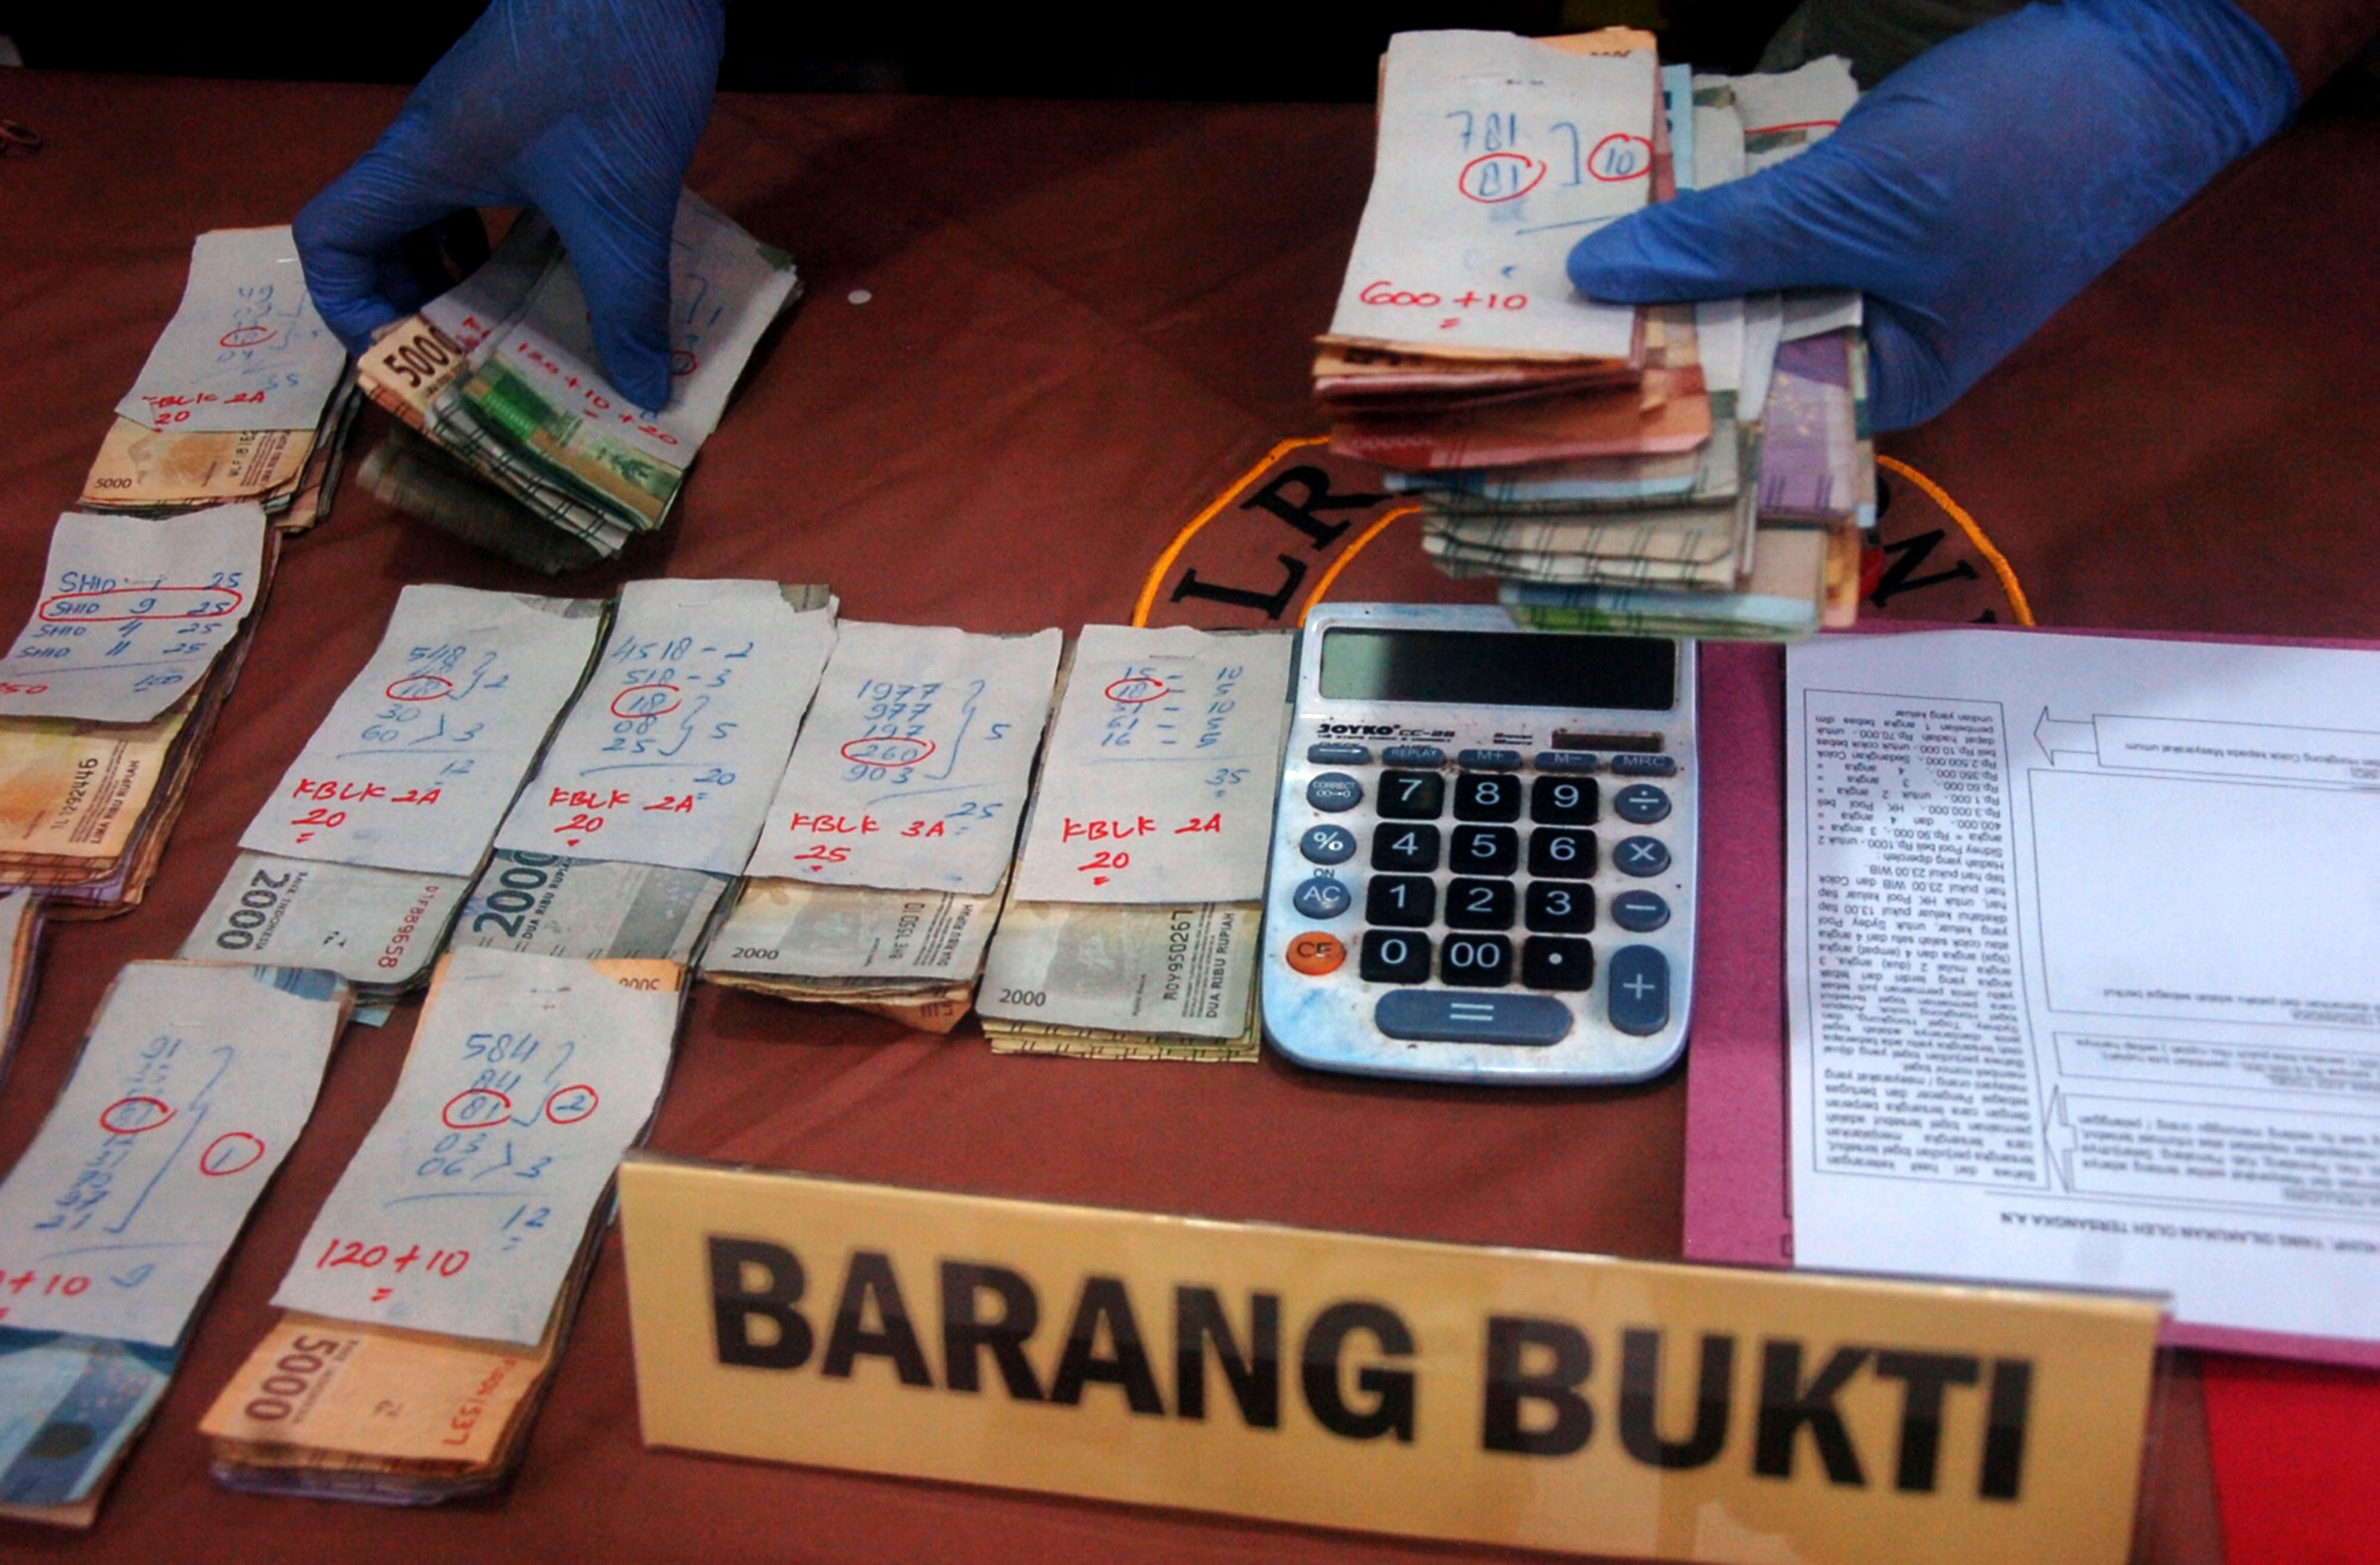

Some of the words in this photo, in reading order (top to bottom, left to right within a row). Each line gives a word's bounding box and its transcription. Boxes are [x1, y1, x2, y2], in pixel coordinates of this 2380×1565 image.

[1445, 111, 1516, 152] 781
[1605, 148, 1635, 175] 10
[1479, 161, 1518, 196] 81
[156, 411, 192, 424] 20
[95, 478, 133, 489] 5000
[205, 572, 242, 589] 25
[187, 602, 230, 615] 25
[178, 622, 223, 634] 25
[163, 643, 208, 654] 25
[1217, 665, 1244, 680] 10
[857, 679, 942, 701] 1977
[628, 693, 666, 714] 18
[1208, 700, 1235, 713] 10
[864, 703, 931, 721] 977
[1895, 710, 1927, 720] keluar
[1930, 710, 1953, 721] yang
[1958, 712, 1993, 723] undian
[985, 724, 1012, 741] 5
[1317, 724, 1393, 735] JOYKO
[1817, 727, 1844, 738] untuk
[602, 738, 656, 753] 25
[1102, 733, 1130, 746] 16
[1817, 738, 1848, 749] bebas
[1922, 734, 1956, 744] hadiah
[1965, 735, 1994, 746] dapat
[853, 744, 919, 762] 260
[1477, 750, 1504, 760] M+
[1883, 742, 1909, 753] untuk
[1978, 748, 1996, 758] beli
[1623, 756, 1665, 767] MRC
[693, 768, 736, 785] 20
[843, 765, 914, 784] 903
[1204, 768, 1250, 785] 35
[293, 778, 386, 802] KBLK
[392, 788, 441, 805] 2A
[1398, 779, 1423, 802] 7
[1475, 782, 1501, 805] 8
[1553, 785, 1579, 808] 9
[549, 787, 630, 809] KBLK
[643, 795, 693, 813] 2A
[1850, 800, 1873, 811] Pool
[1887, 803, 1903, 813] HK
[292, 808, 347, 827] 20
[945, 802, 1003, 819] 25
[554, 813, 604, 833] 20
[791, 813, 881, 835] KBLK
[901, 821, 946, 837] 3A
[1063, 816, 1157, 843] KBLK
[1174, 813, 1222, 834] 2A
[1314, 832, 1343, 851] %
[1392, 833, 1418, 855] 4
[1471, 834, 1497, 857] 5
[1818, 835, 1824, 845] 2
[1829, 837, 1857, 847] untuk
[794, 844, 851, 862] 25
[1550, 837, 1576, 860] 6
[1916, 843, 1936, 854] beli
[1939, 844, 1962, 855] Pool
[1966, 844, 2003, 857] Sidney
[1078, 852, 1129, 871] 20
[1883, 853, 1933, 866] diperoleh
[1936, 855, 1962, 867] yang
[1965, 858, 2004, 869] Hadiah
[1314, 868, 1335, 878] ON
[1820, 875, 1850, 885] Colok
[1883, 879, 1906, 888] WIB
[1912, 881, 1943, 892] 23.00
[1949, 884, 1978, 894] pukul
[1303, 886, 1340, 902] AC
[1390, 885, 1406, 907] 1
[1467, 888, 1493, 912] 2
[217, 869, 291, 950] 2000
[1546, 892, 1571, 915] 3
[1844, 905, 1874, 915] 13.00
[522, 912, 542, 940] DUA
[536, 893, 556, 916] RIBU
[1882, 906, 1911, 918] pukul
[1918, 910, 1951, 920] keluar
[1958, 912, 2007, 924] diketahui
[1217, 913, 1235, 954] RUPIAH
[731, 947, 779, 960] 2000
[1297, 942, 1333, 957] CE
[1381, 940, 1407, 963] 0
[1450, 943, 1501, 968] 00
[1211, 958, 1227, 990] RIBU
[998, 989, 1047, 1007] 2000
[1205, 993, 1220, 1019] DUA
[463, 1033, 538, 1063] 584
[556, 1095, 585, 1111] 2
[514, 1156, 552, 1178] 3
[502, 1204, 551, 1232] 12
[707, 1234, 1418, 1444] BARANG
[1482, 1315, 2033, 1504] BUKTI
[244, 1336, 339, 1422] 5000
